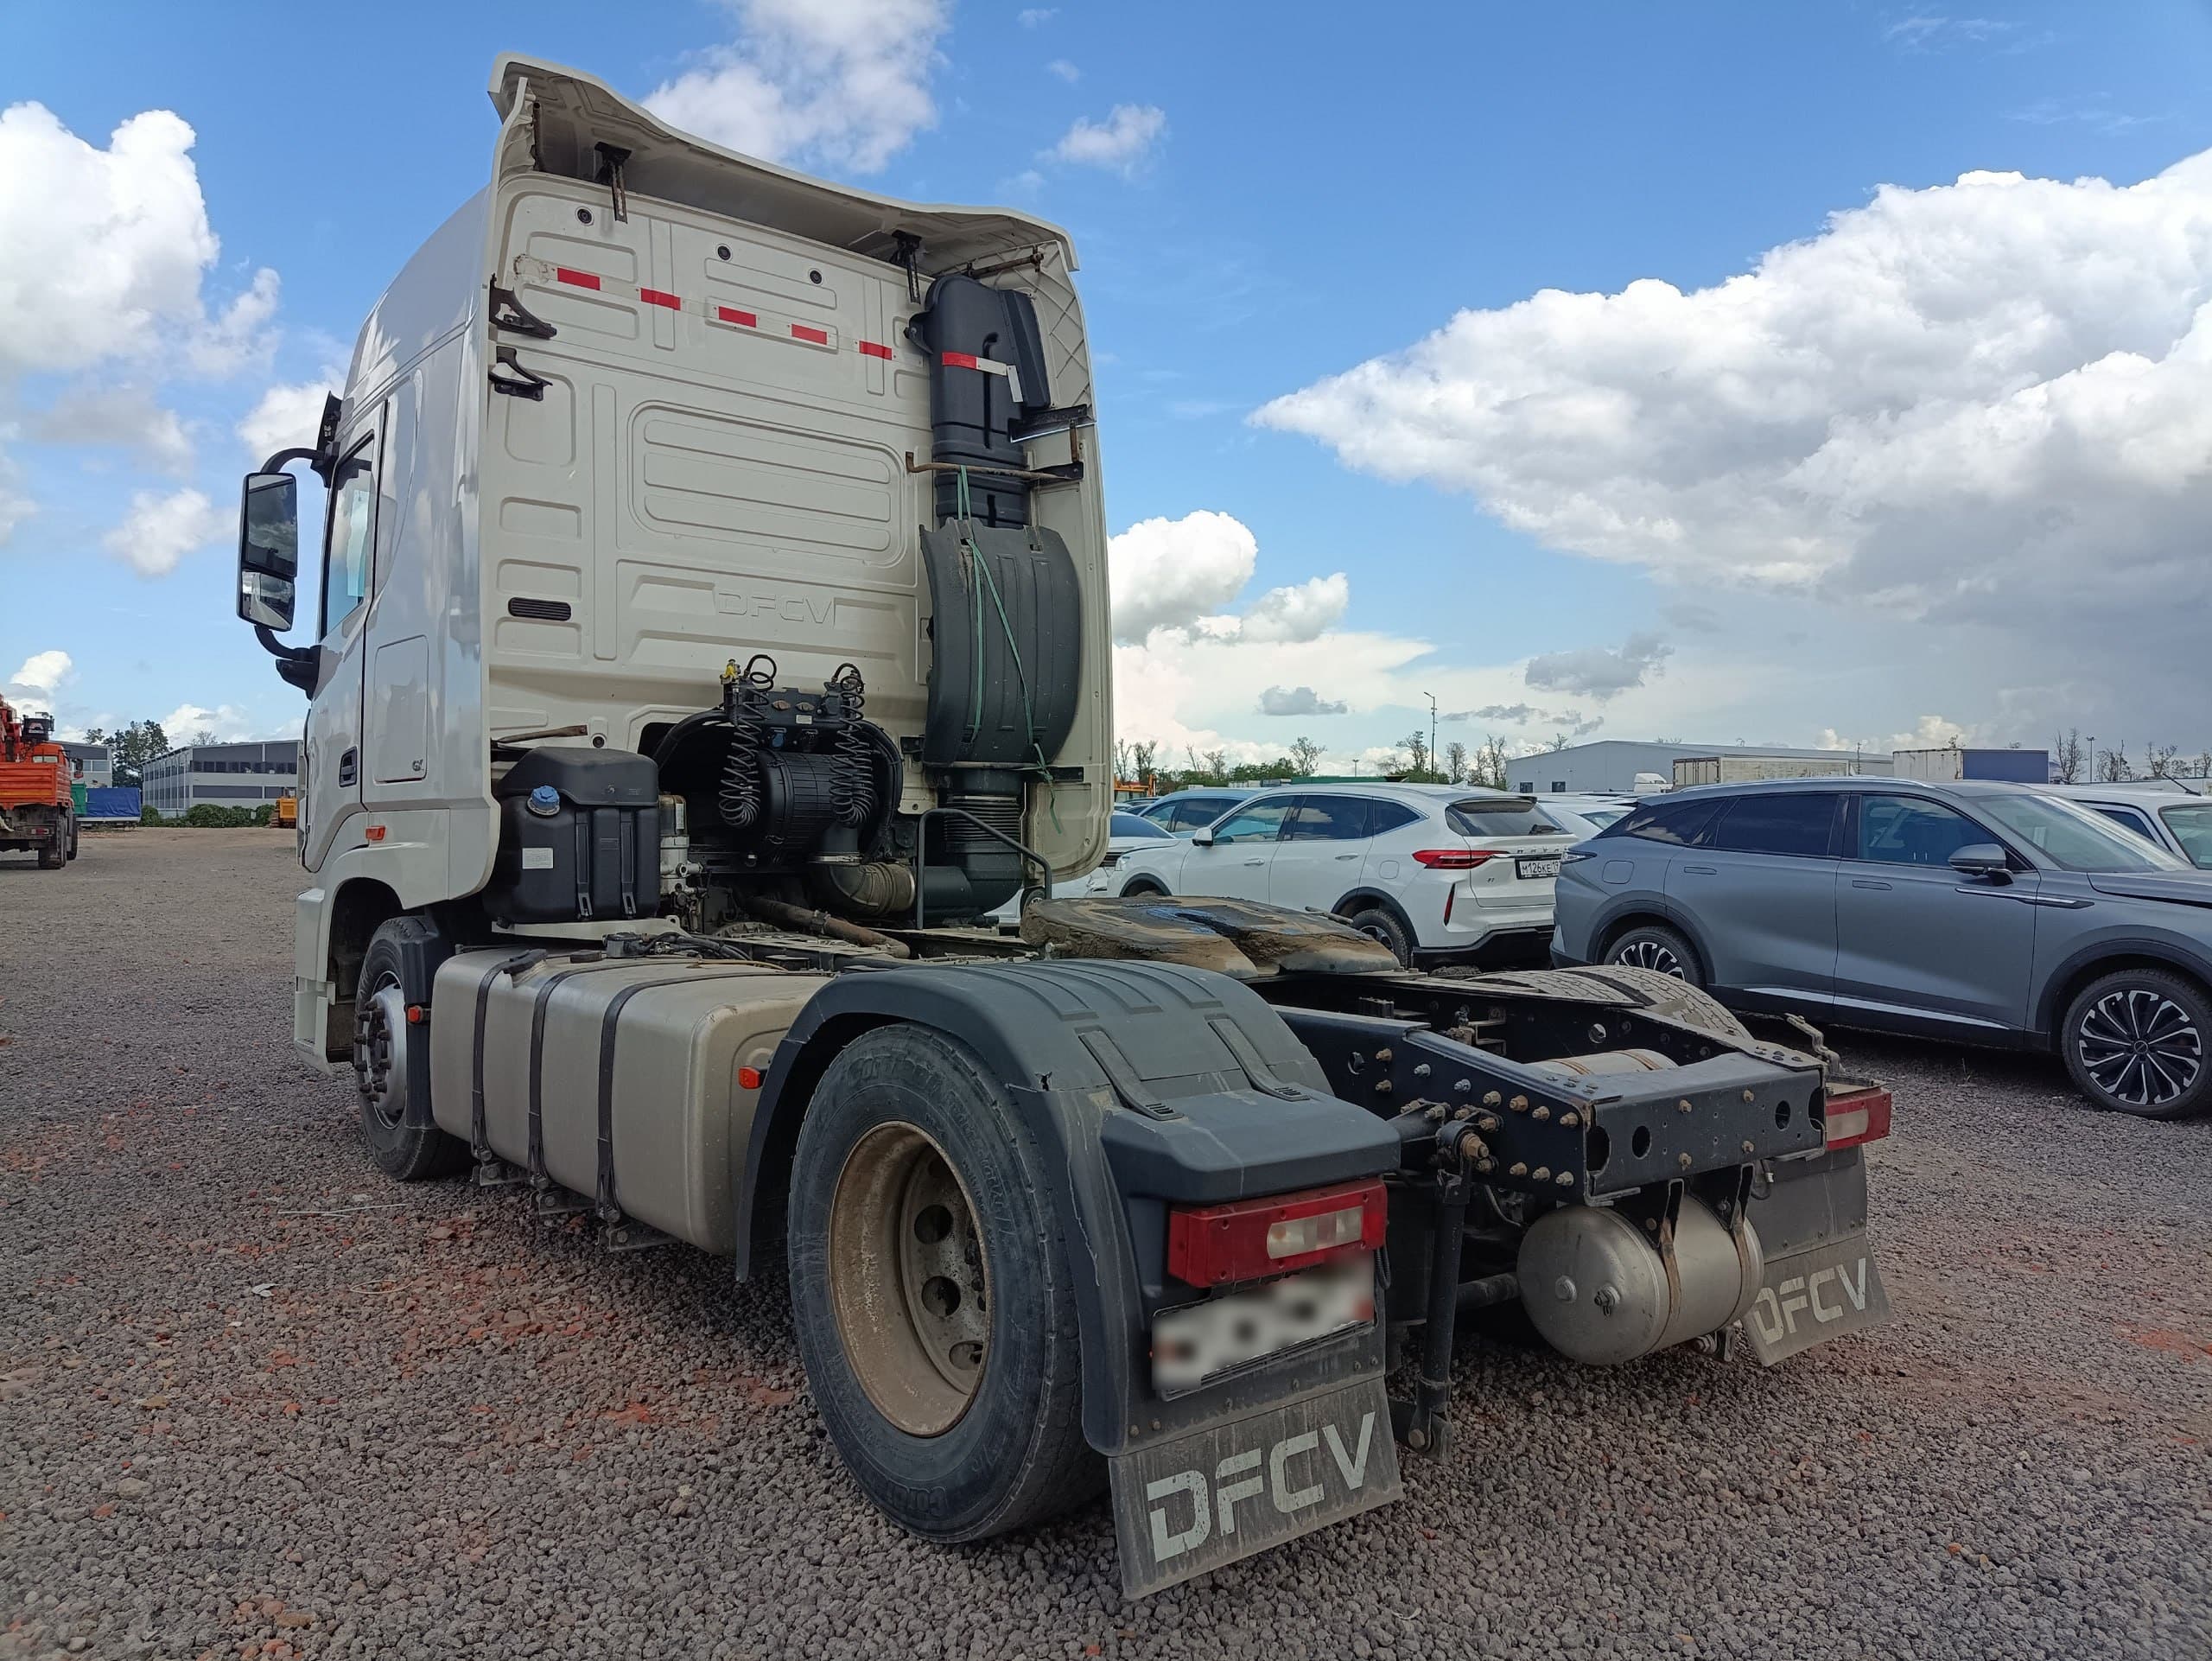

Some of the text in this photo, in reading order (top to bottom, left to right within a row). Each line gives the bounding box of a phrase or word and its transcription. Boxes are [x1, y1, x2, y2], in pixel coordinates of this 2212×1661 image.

[717, 592, 832, 624] DFCV
[1754, 1257, 1866, 1346] DFCV
[1147, 1411, 1376, 1562] DFCV
